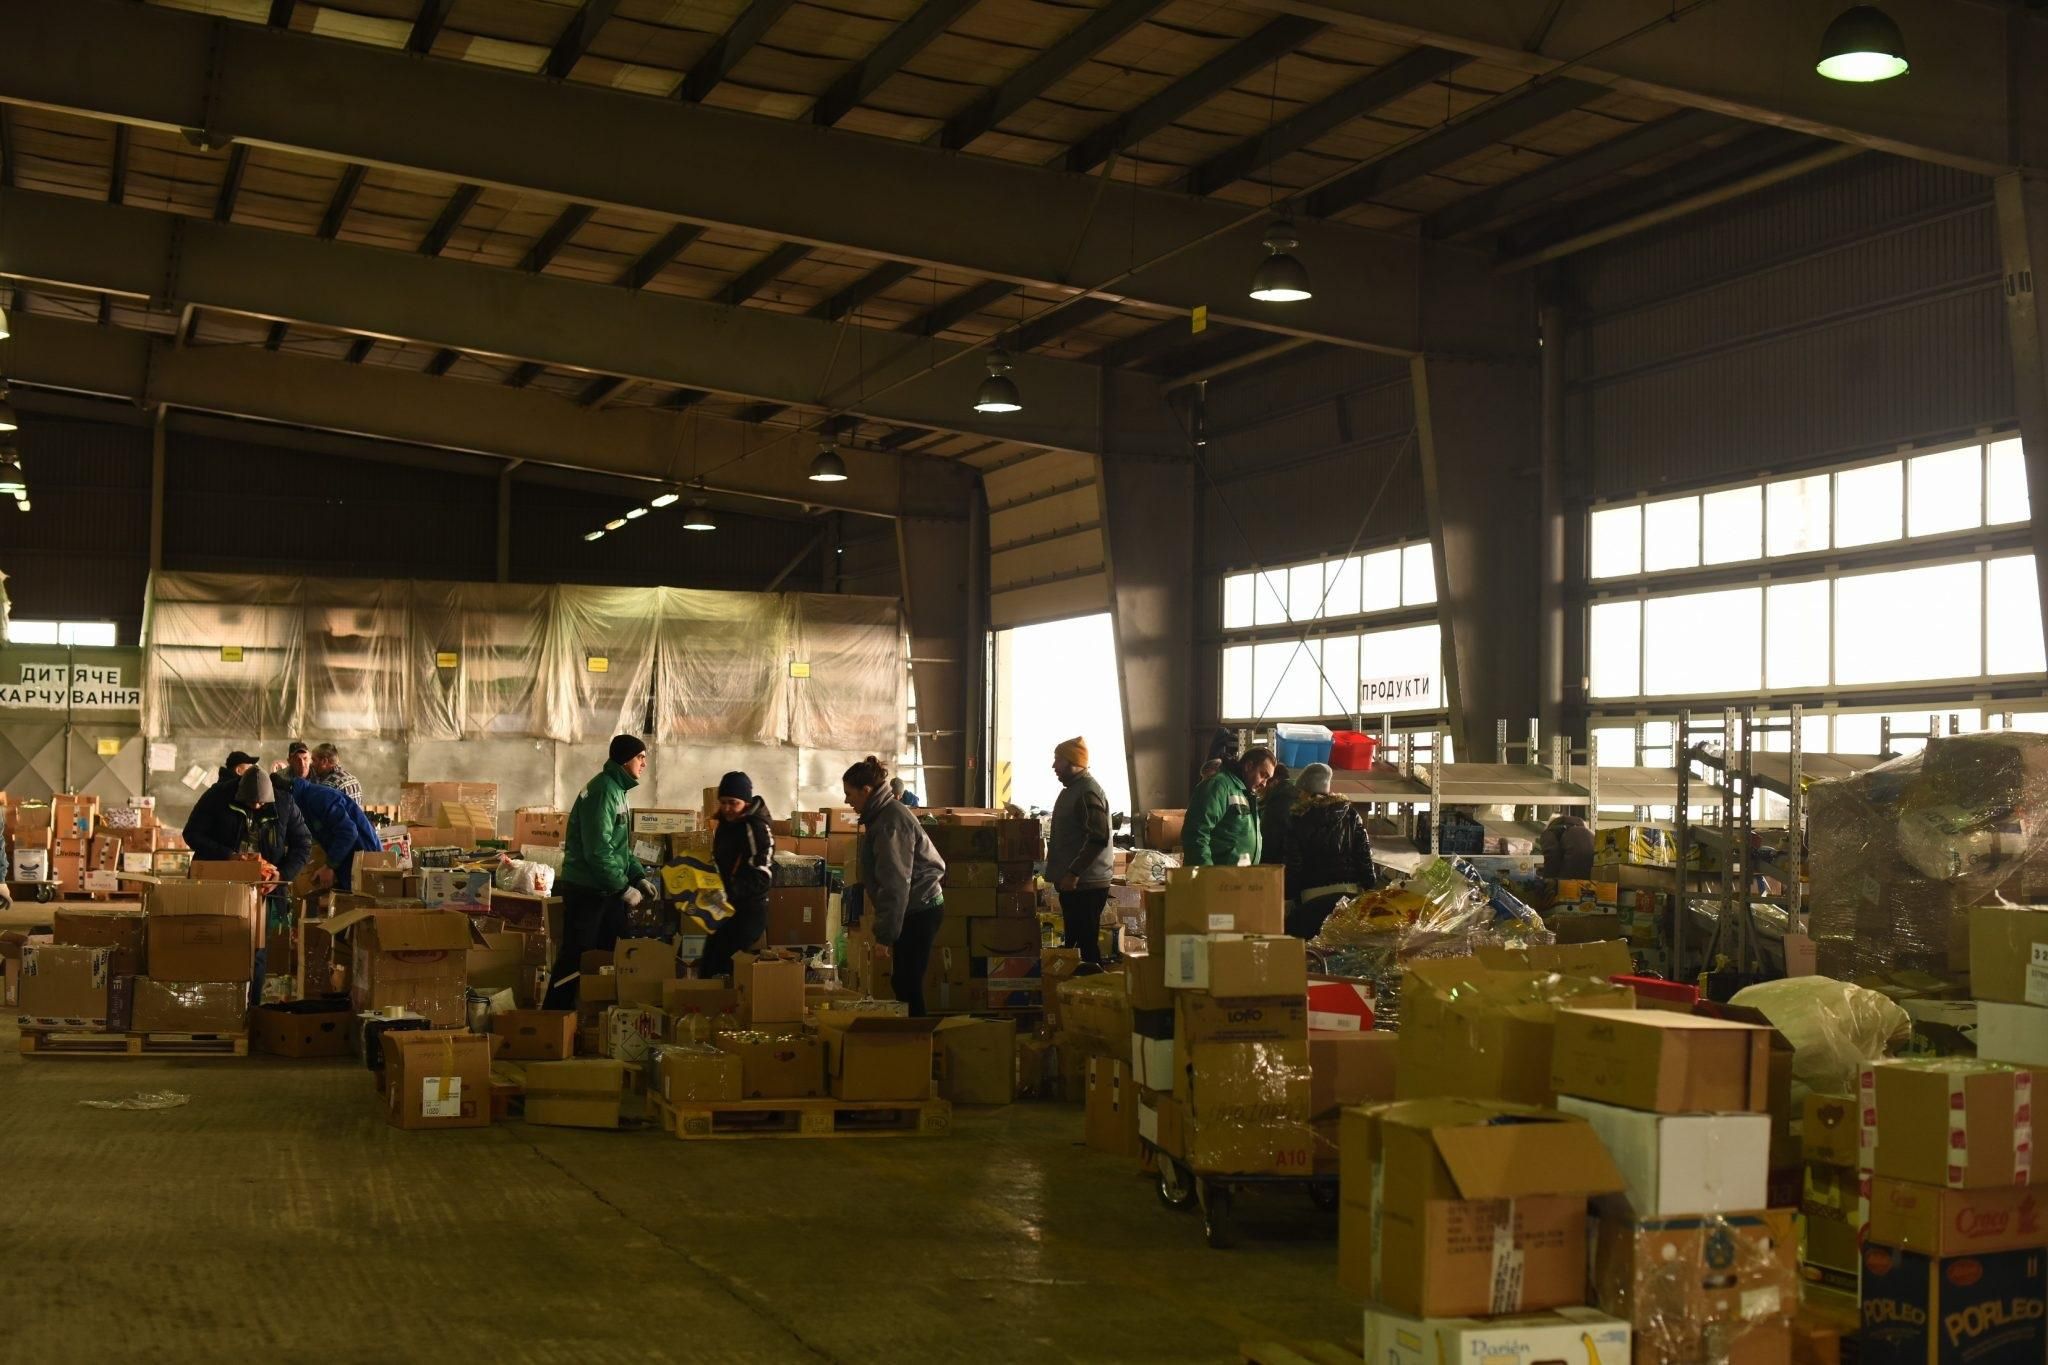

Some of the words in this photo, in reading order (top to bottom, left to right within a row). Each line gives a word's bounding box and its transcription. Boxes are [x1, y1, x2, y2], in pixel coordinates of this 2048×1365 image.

[22, 667, 118, 684] ДИТЯЧЕ
[1362, 677, 1429, 701] ПРОДУКТИ
[1275, 1149, 1307, 1167] A10
[1863, 1298, 1926, 1327] PORLEO
[1944, 1297, 2045, 1348] PORLEO
